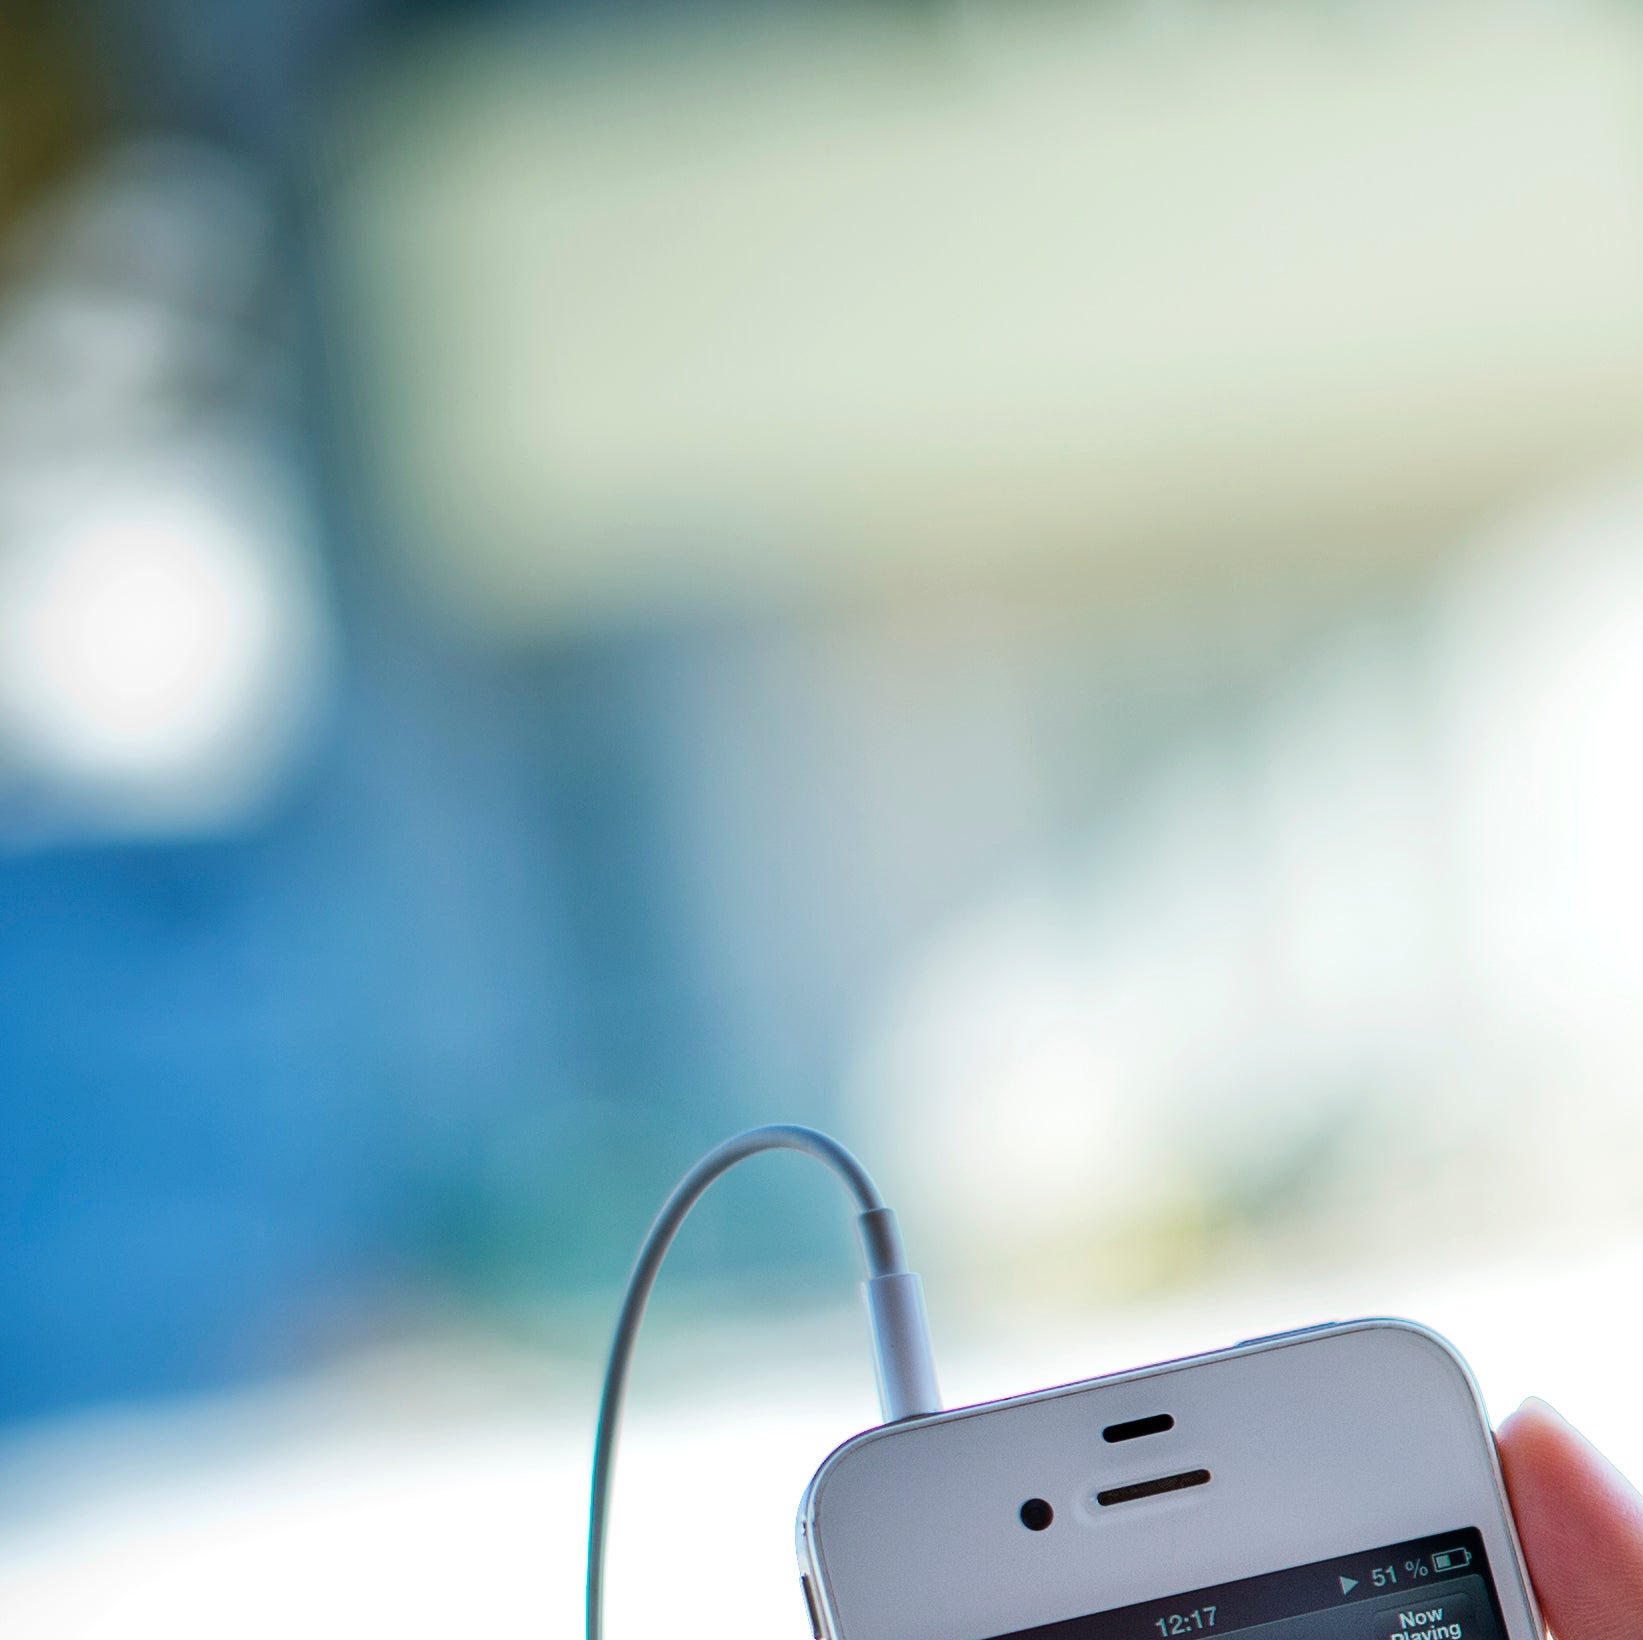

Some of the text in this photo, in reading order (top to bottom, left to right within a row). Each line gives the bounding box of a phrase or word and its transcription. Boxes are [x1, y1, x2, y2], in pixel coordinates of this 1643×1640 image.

[1371, 1558, 1429, 1588] 51 %
[1154, 1605, 1218, 1638] 12:17
[1399, 1607, 1444, 1629] Now
